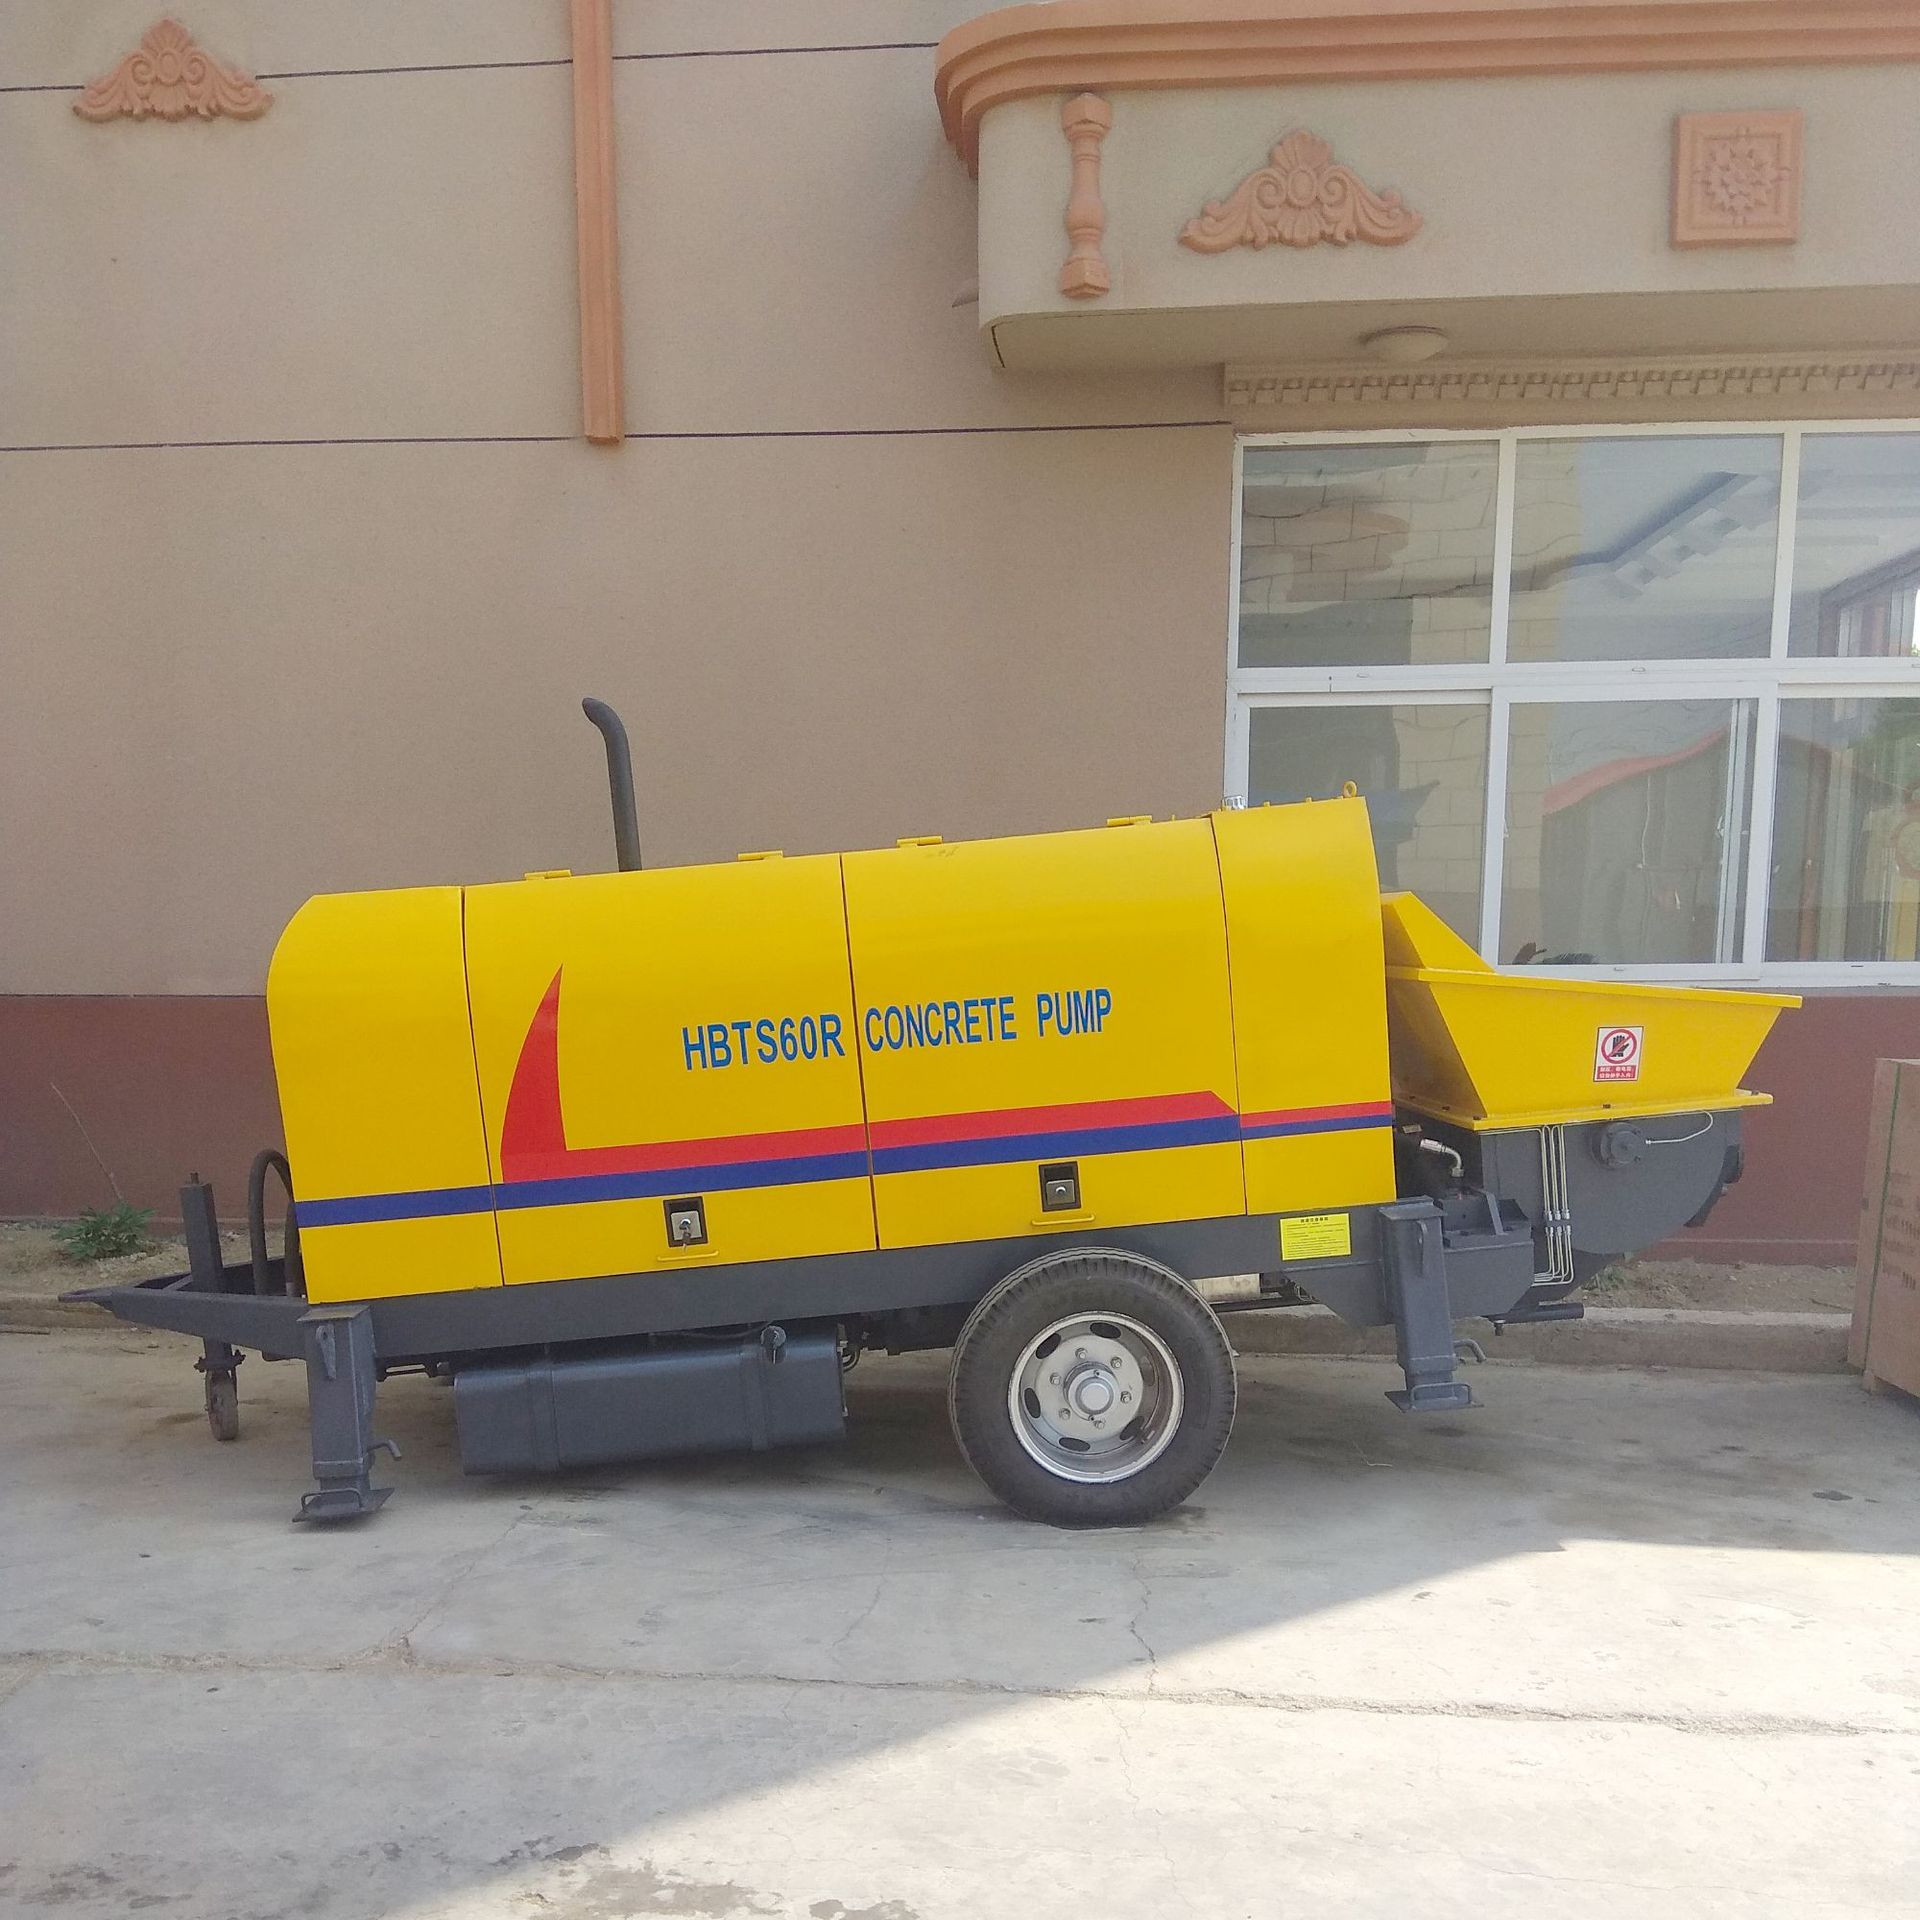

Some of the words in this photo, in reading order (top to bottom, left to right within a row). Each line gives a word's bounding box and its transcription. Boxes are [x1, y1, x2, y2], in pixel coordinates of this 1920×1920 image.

[682, 1013, 846, 1070] HBTS60R
[865, 995, 1018, 1052] CONCRETE
[1036, 988, 1112, 1037] PUMP
